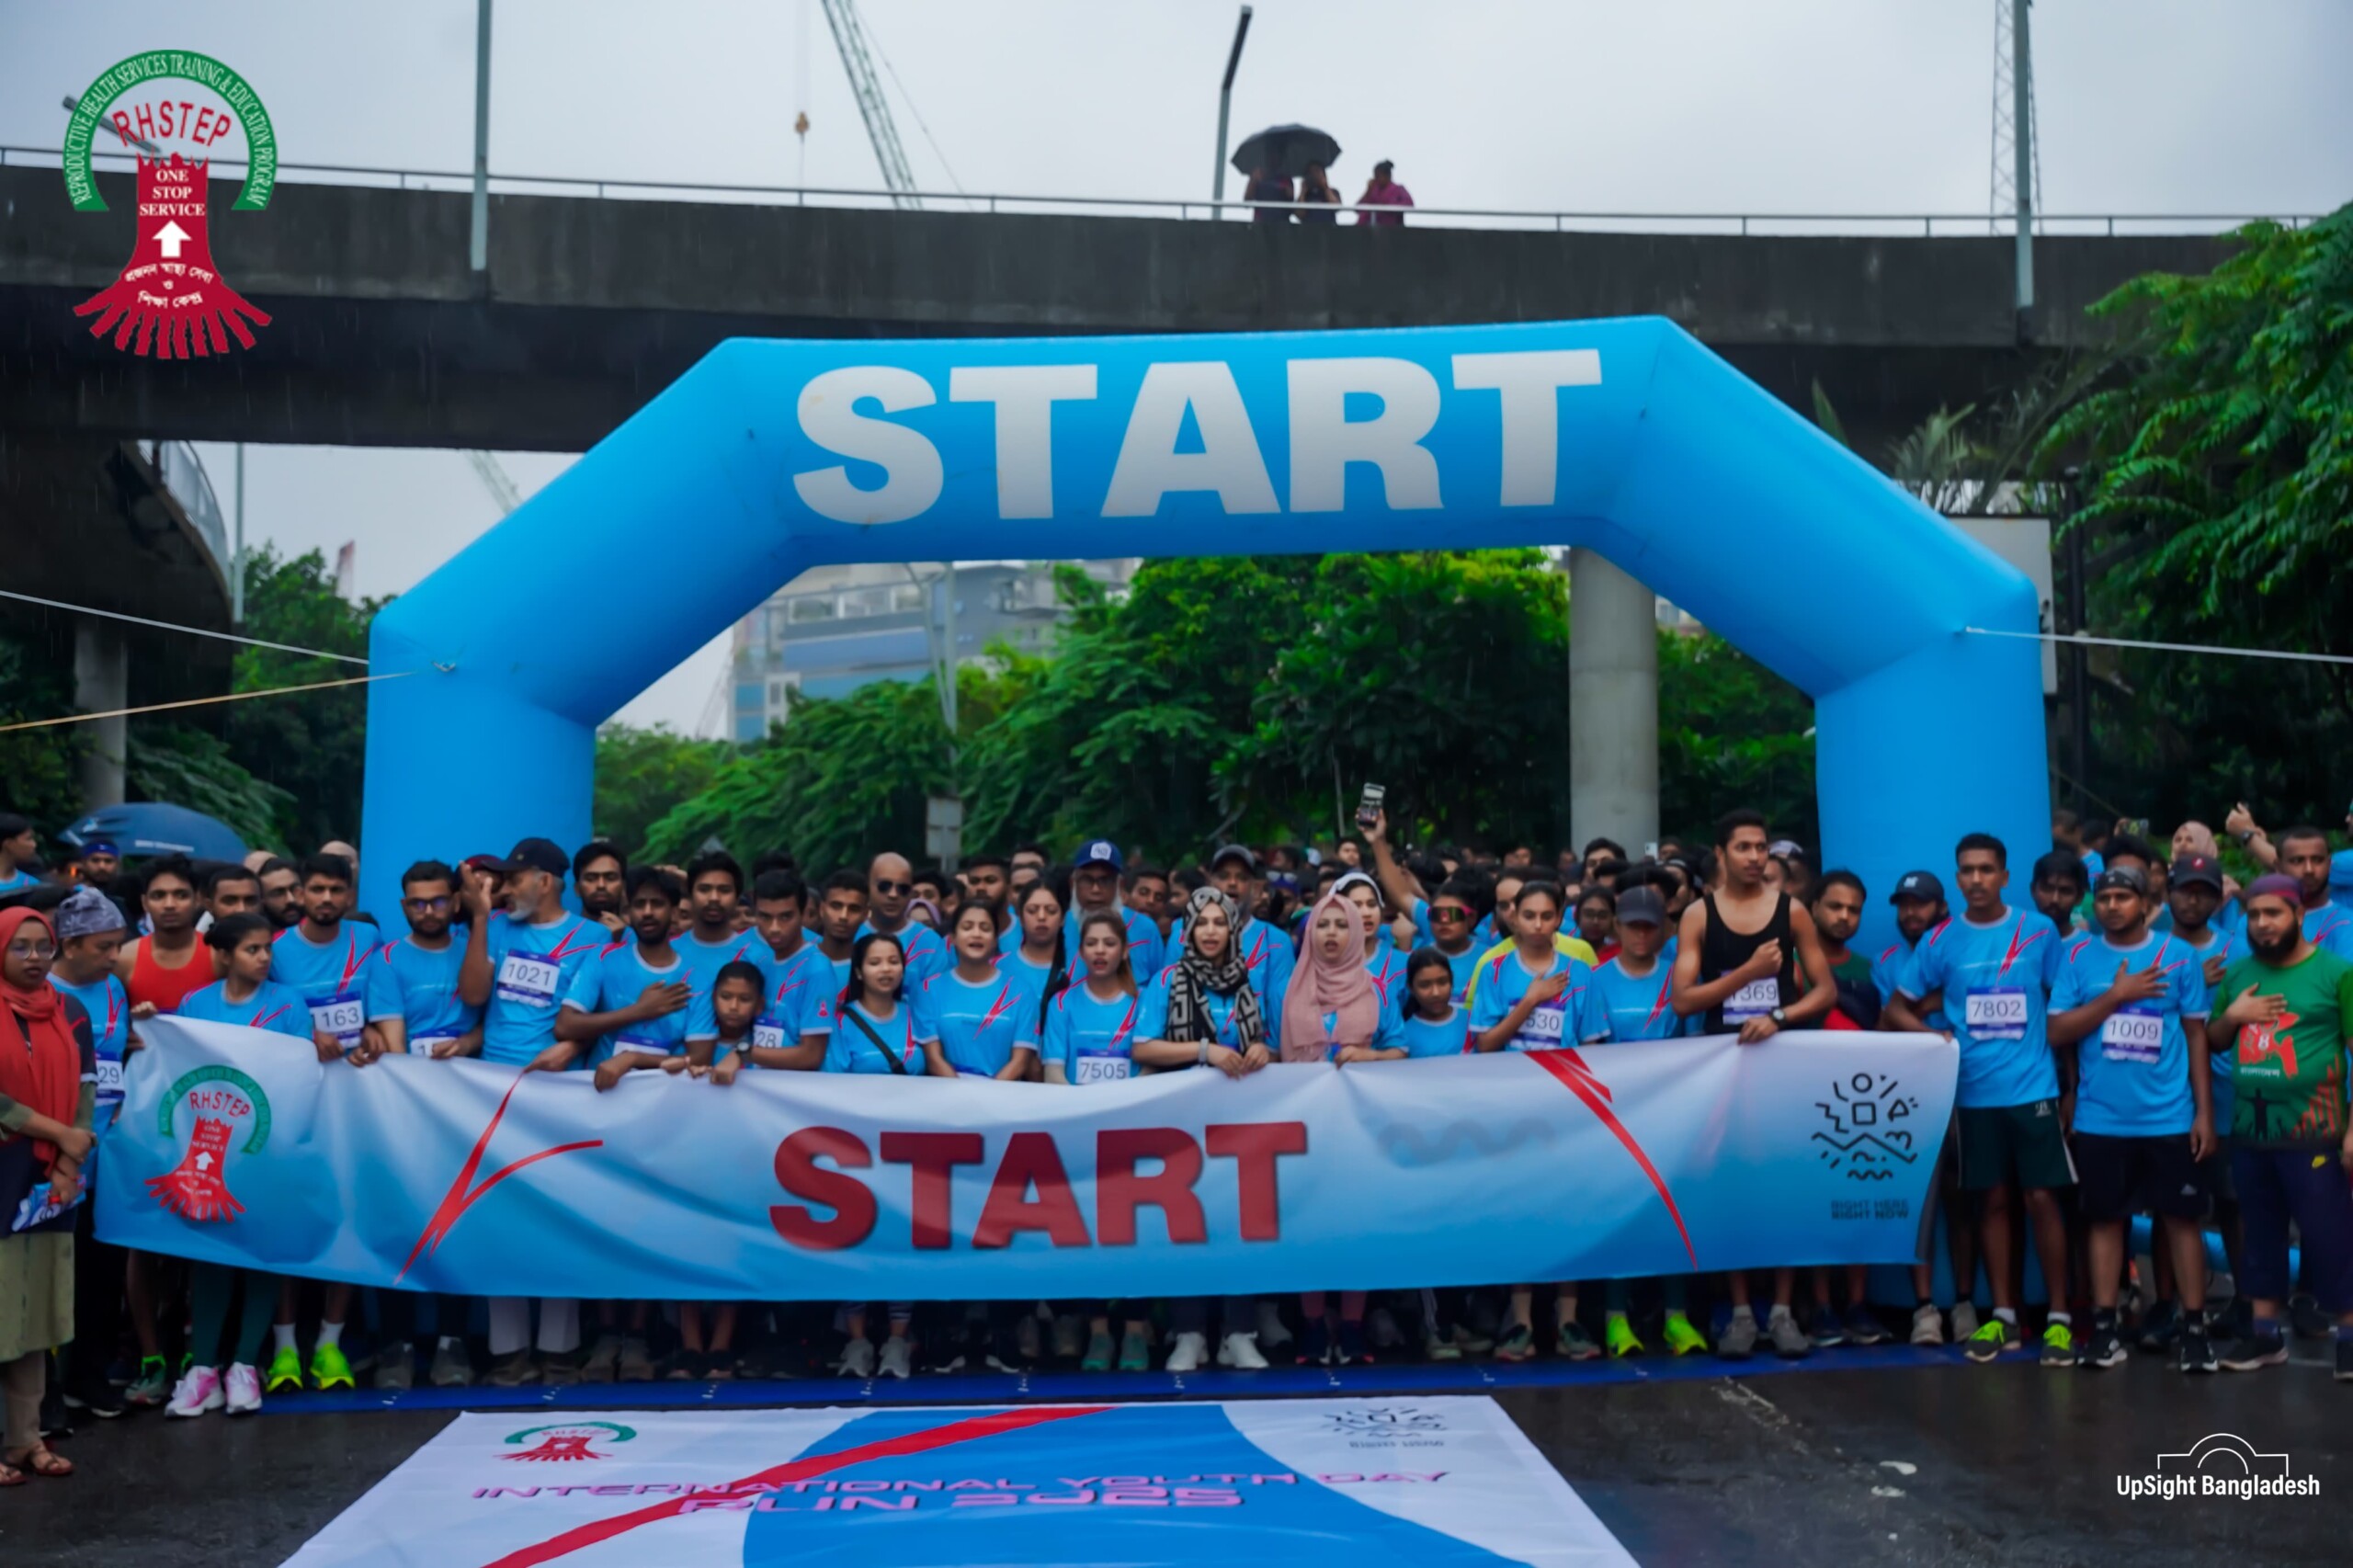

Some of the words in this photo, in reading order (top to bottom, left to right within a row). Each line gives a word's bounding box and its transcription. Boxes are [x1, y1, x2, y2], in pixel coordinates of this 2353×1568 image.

[792, 348, 1602, 525] START
[508, 963, 551, 986] 1021
[1970, 999, 2022, 1018] 7802
[2109, 1019, 2160, 1040] 1009
[1079, 1062, 1128, 1080] 7505
[189, 1091, 251, 1118] RHSTEP
[769, 1120, 1307, 1251] START
[472, 1478, 1038, 1498] INTERNATIONAL
[1057, 1473, 1299, 1487] YOUTH
[1316, 1471, 1447, 1484] DAY
[677, 1494, 920, 1514] RUN
[951, 1485, 1243, 1507] 2025
